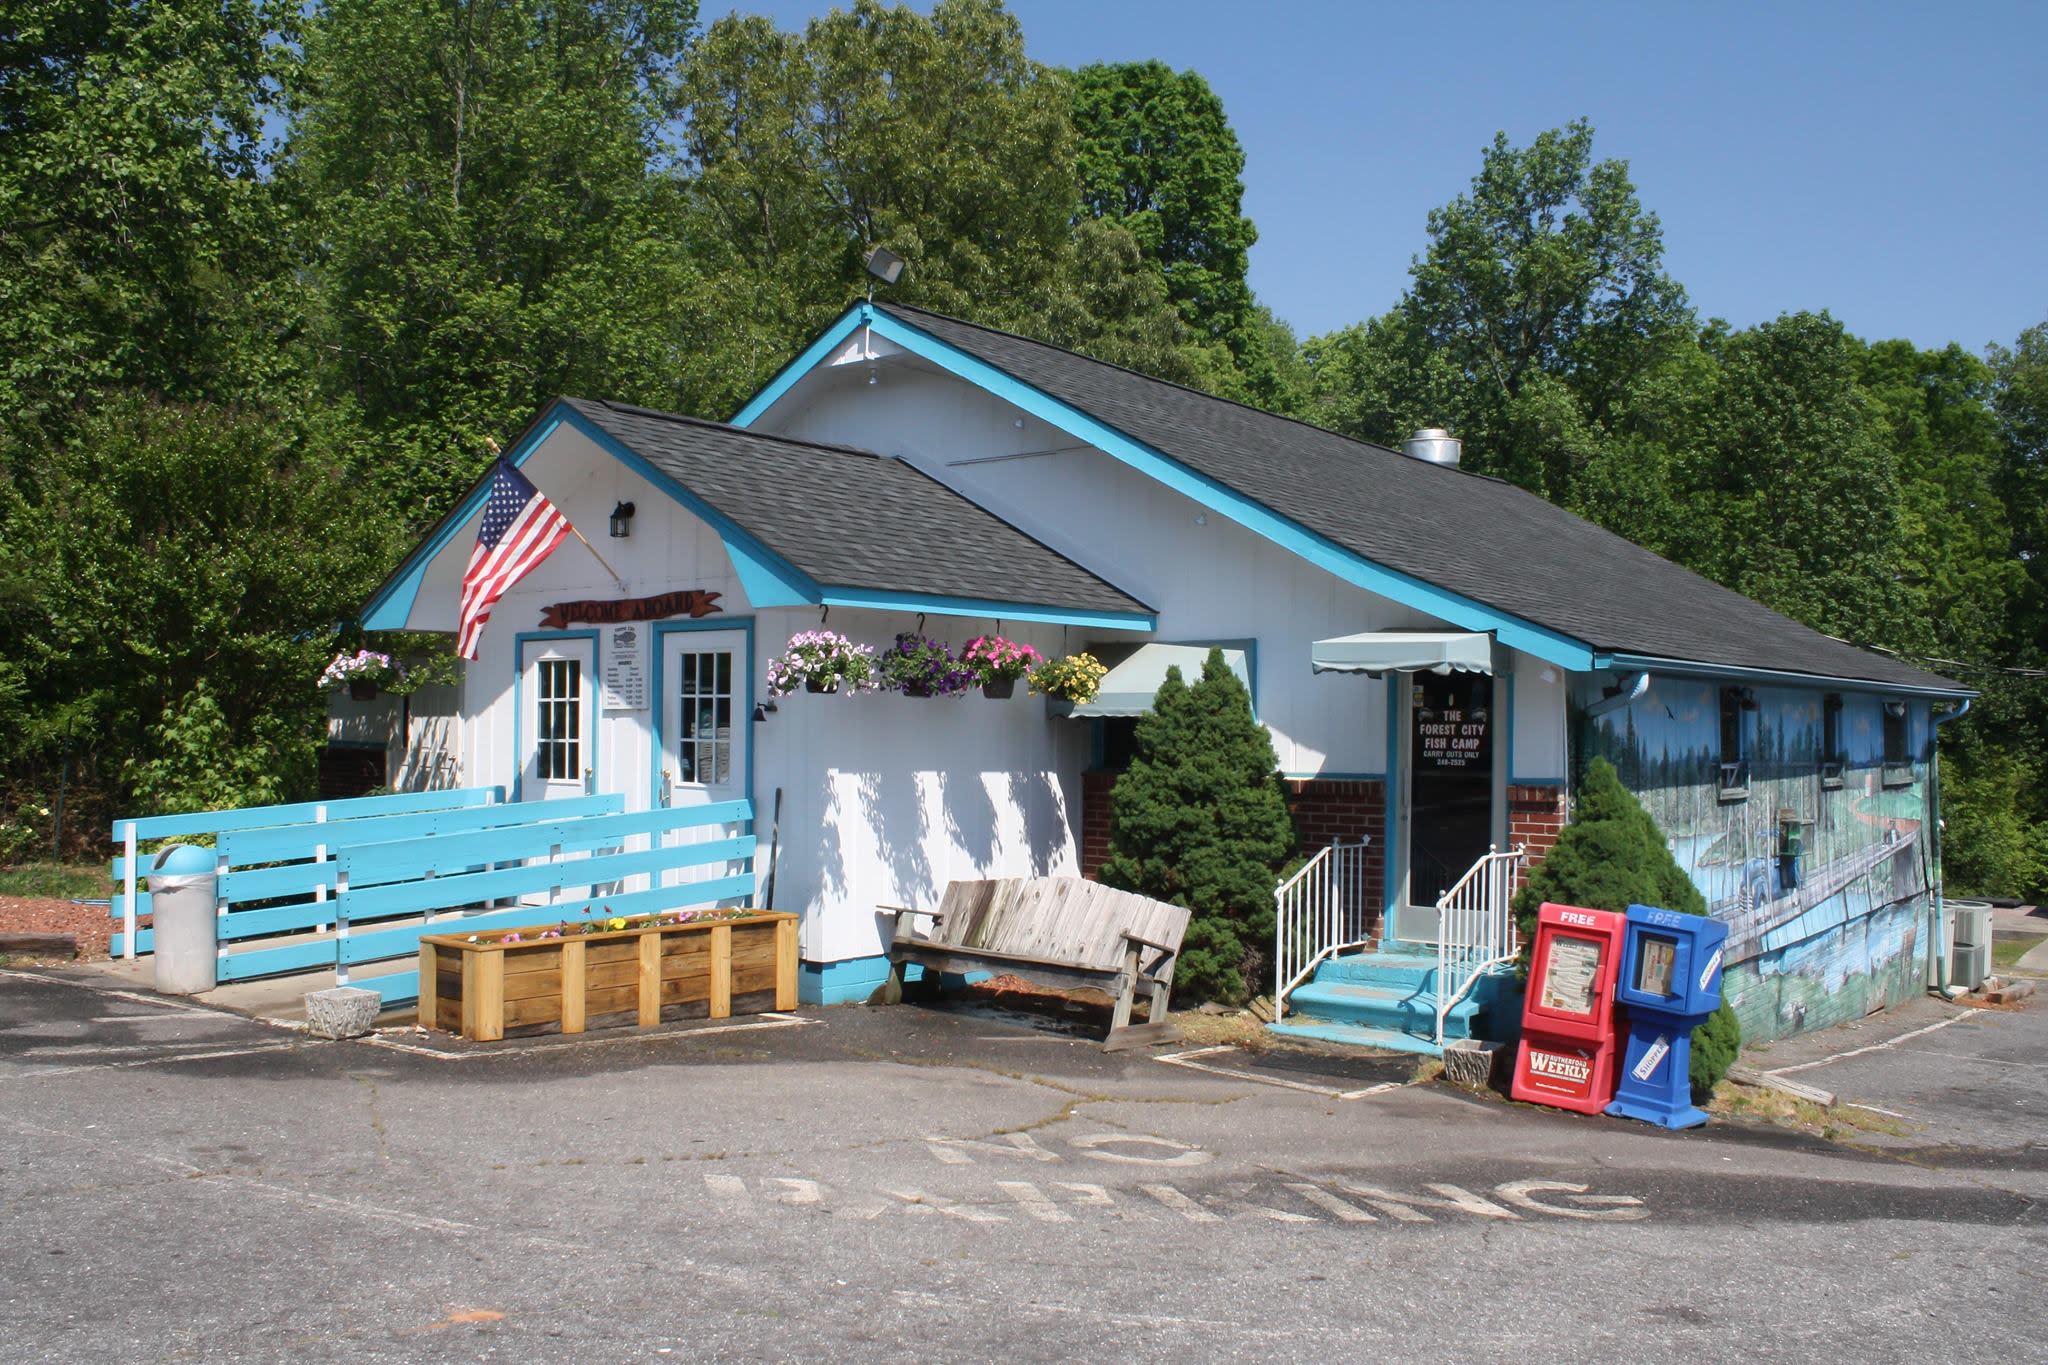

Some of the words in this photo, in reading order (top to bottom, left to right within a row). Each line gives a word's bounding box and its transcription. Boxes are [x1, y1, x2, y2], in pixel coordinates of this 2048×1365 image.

[559, 602, 621, 622] WELCOME
[633, 592, 694, 620] ABOARD
[1444, 710, 1461, 721] THE
[1420, 724, 1456, 735] FOREST
[1461, 724, 1485, 735] CITY
[1425, 738, 1446, 749] FISH
[1452, 738, 1479, 749] CAMP
[1560, 911, 1596, 926] FREE
[1647, 911, 1682, 927] FREE
[1530, 1051, 1590, 1079] WEEKLY
[1550, 1055, 1587, 1067] RUTHERFORD
[1640, 1042, 1666, 1075] SHOPPER
[923, 1131, 1214, 1167] NO
